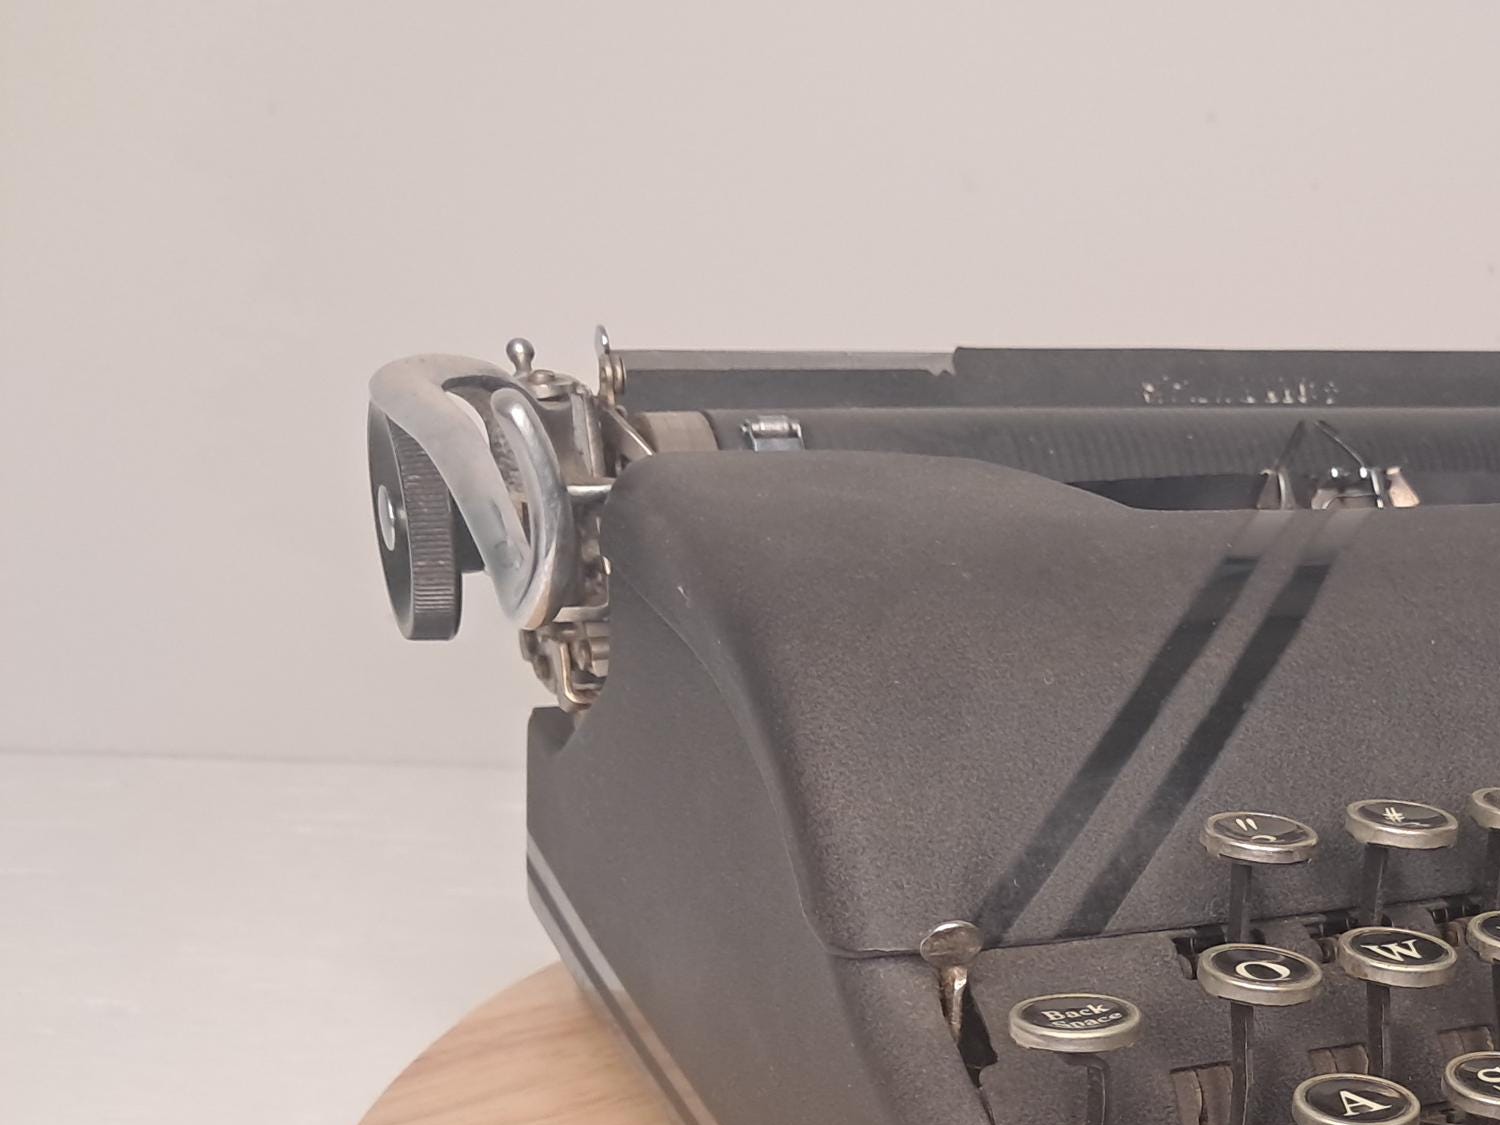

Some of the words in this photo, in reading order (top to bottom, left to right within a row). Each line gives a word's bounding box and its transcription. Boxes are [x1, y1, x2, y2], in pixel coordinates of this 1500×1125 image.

[1383, 807, 1405, 823] #
[1361, 939, 1417, 962] W
[1041, 1002, 1111, 1022] Back
[1339, 1090, 1393, 1116] A
